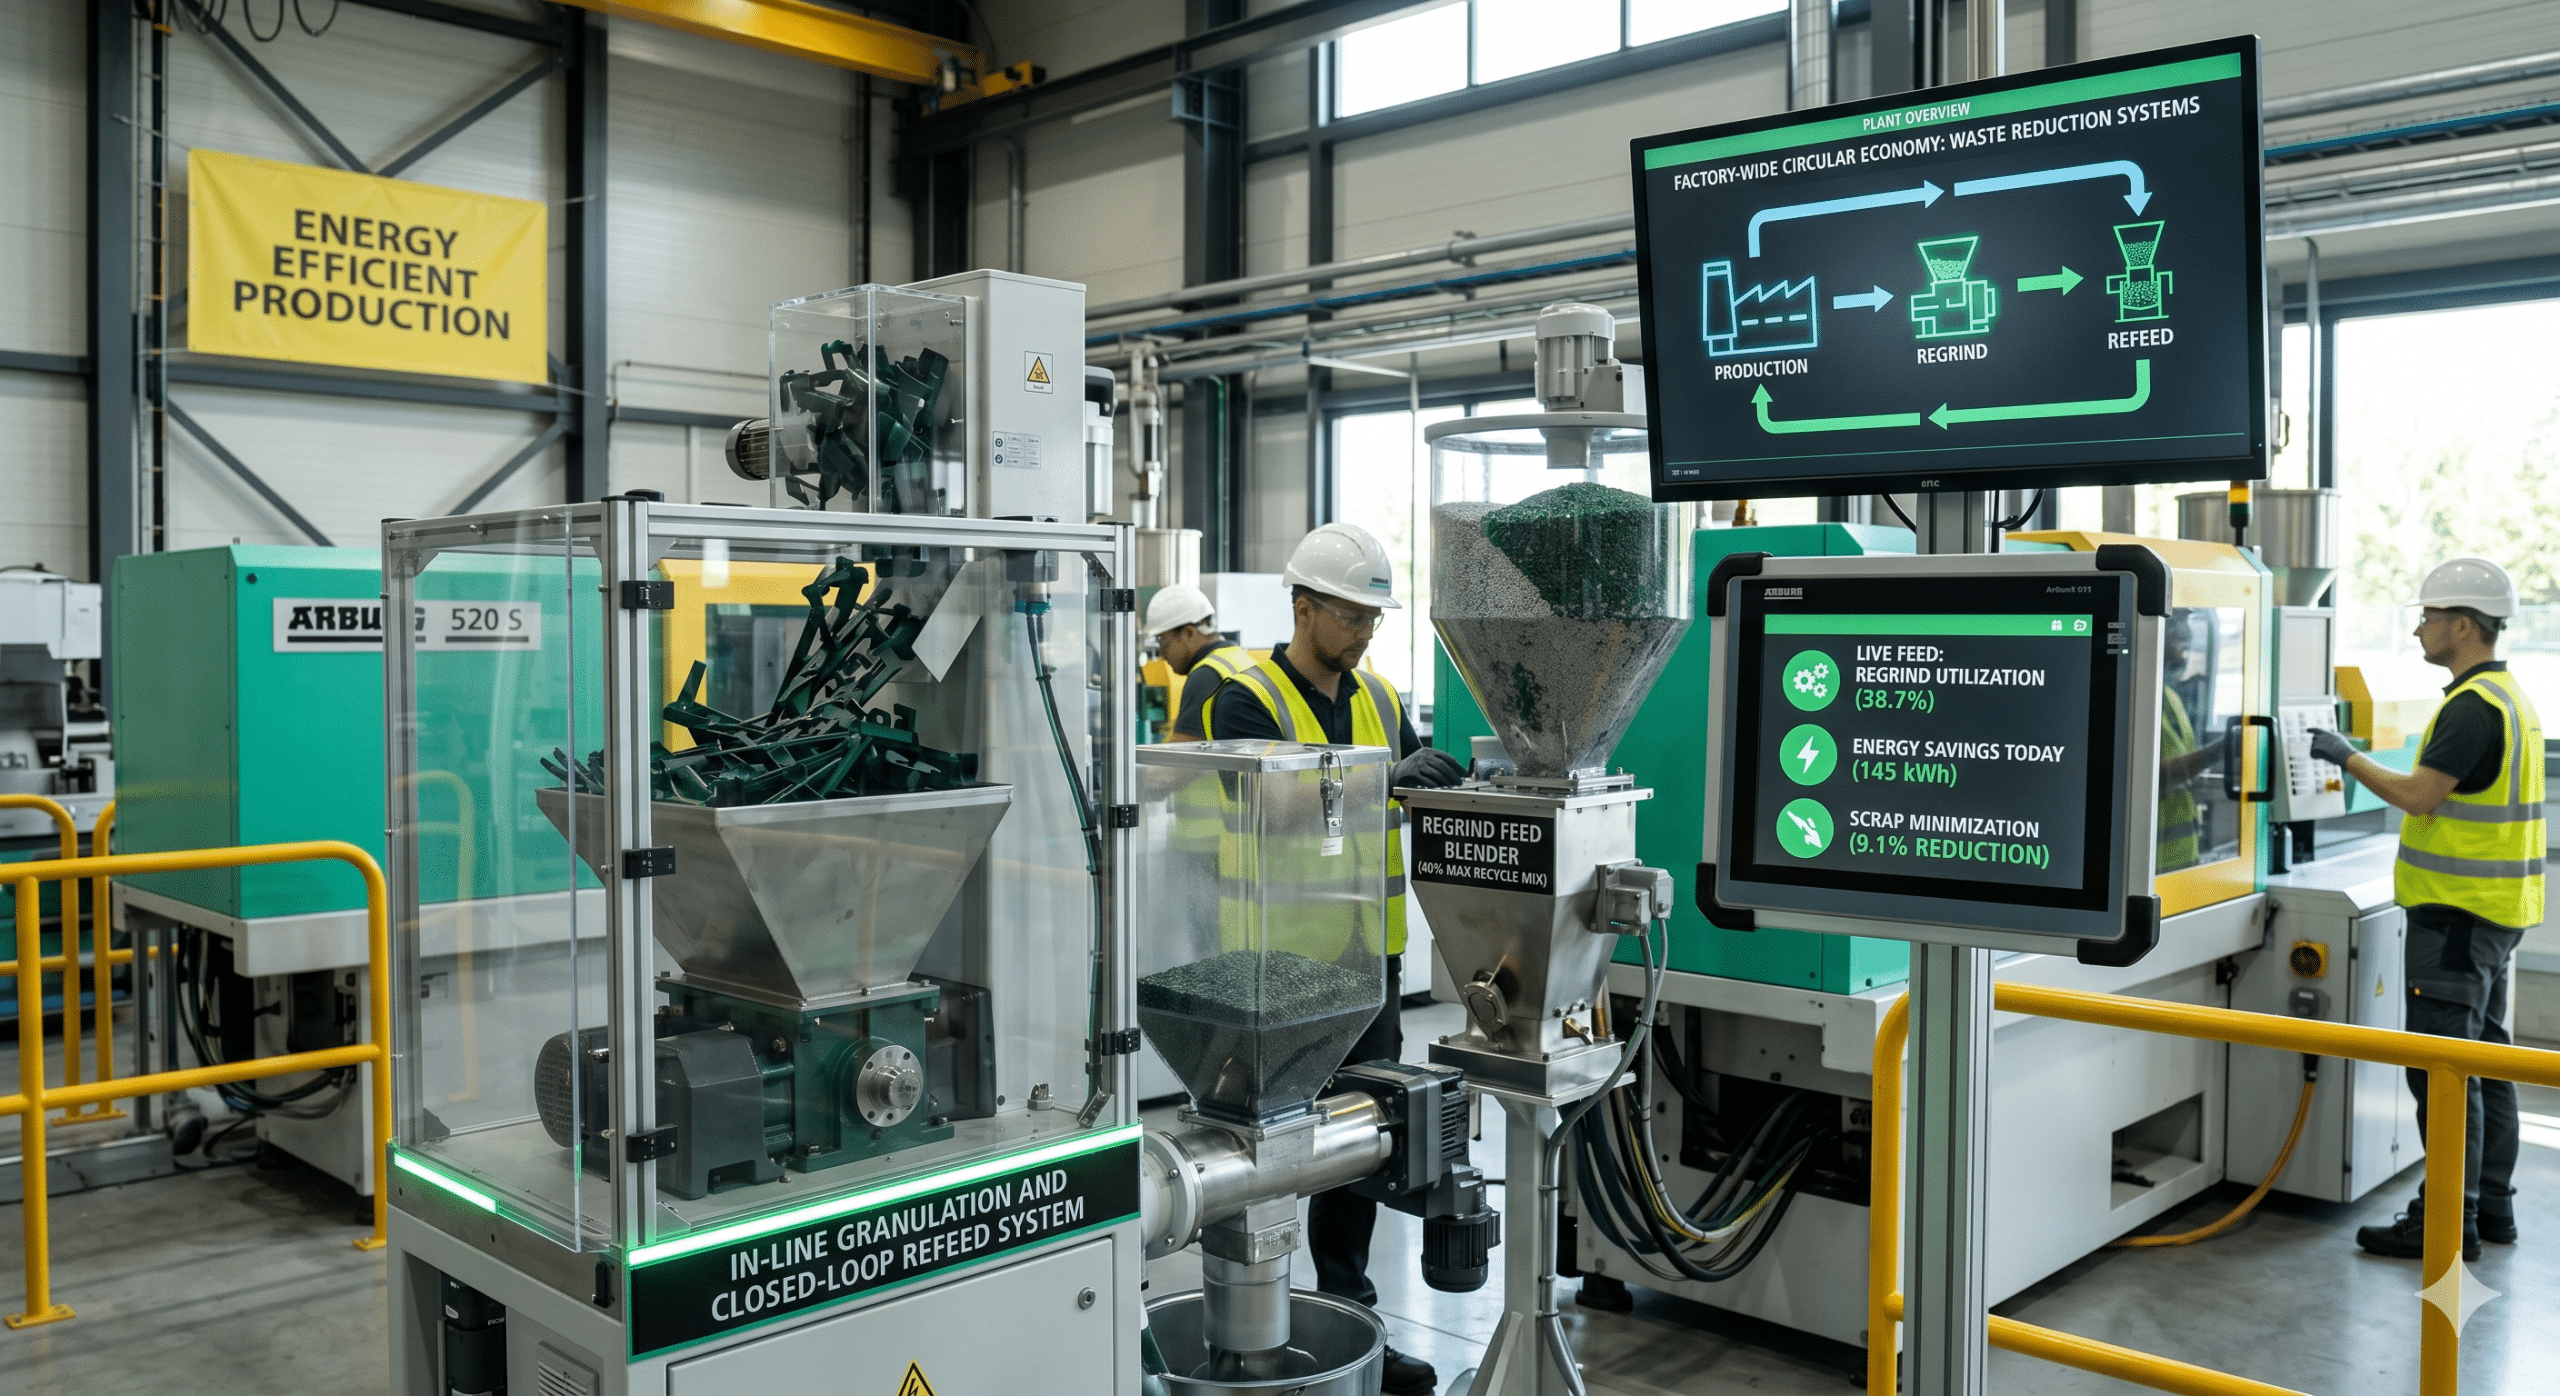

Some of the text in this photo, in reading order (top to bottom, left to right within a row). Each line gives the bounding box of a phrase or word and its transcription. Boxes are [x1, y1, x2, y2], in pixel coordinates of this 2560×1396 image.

[1863, 102, 1970, 131] PLANT OVERVIEW
[1675, 96, 2200, 190] FACTORY-WIDE CIRCULAR ECONOMY: WASTE REDUCTION SYSTEMS
[296, 210, 457, 258] ENERGY
[274, 246, 477, 298] EFFICIENT
[234, 280, 509, 339] PRODUCTION
[2109, 328, 2173, 349] REFEED
[1918, 344, 1987, 364] REGRIND
[1715, 359, 1807, 380] PRODUCTION
[288, 606, 522, 630] ARBUG 520 S
[1857, 646, 1943, 661] LIVE FEED:
[1856, 667, 2044, 685] REGRIND UTILIZATION
[1856, 688, 1934, 713] (38.7%)
[1854, 739, 2064, 762] ENERGY SAVINGS TODAY
[1853, 759, 1956, 787] (145 kWh)
[1423, 816, 1541, 842] REGRIND FEED
[1850, 811, 2038, 838] SCRAP MINIMIZATION
[1446, 842, 1518, 865] BLENDER
[1850, 832, 2049, 869] (9.1% REDUCTION)
[1418, 861, 1547, 887] (40% MAX RECYCLE MIX)
[732, 1170, 1066, 1280] IN-LINE GRANULATION AND
[711, 1196, 1083, 1322] CLOSED-LOOP REFEED SYSTEM
